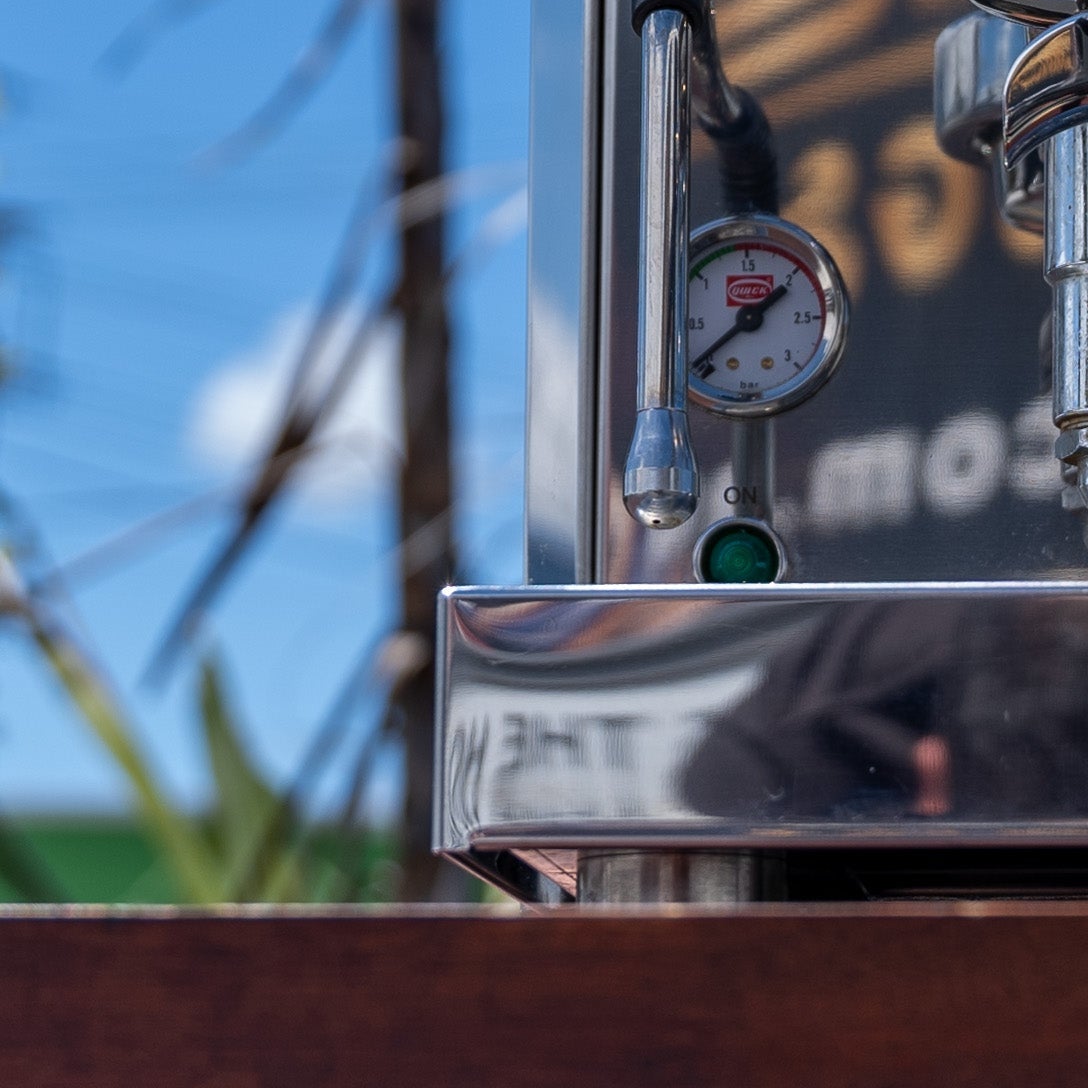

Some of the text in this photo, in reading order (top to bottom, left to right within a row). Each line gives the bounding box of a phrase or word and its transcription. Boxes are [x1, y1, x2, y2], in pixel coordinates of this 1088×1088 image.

[741, 259, 756, 272] 1.5
[785, 274, 793, 287] 2
[731, 285, 768, 296] QUICK
[794, 311, 811, 324] 2.5
[784, 349, 792, 362] 3
[740, 380, 759, 389] bar
[724, 486, 757, 505] ON
